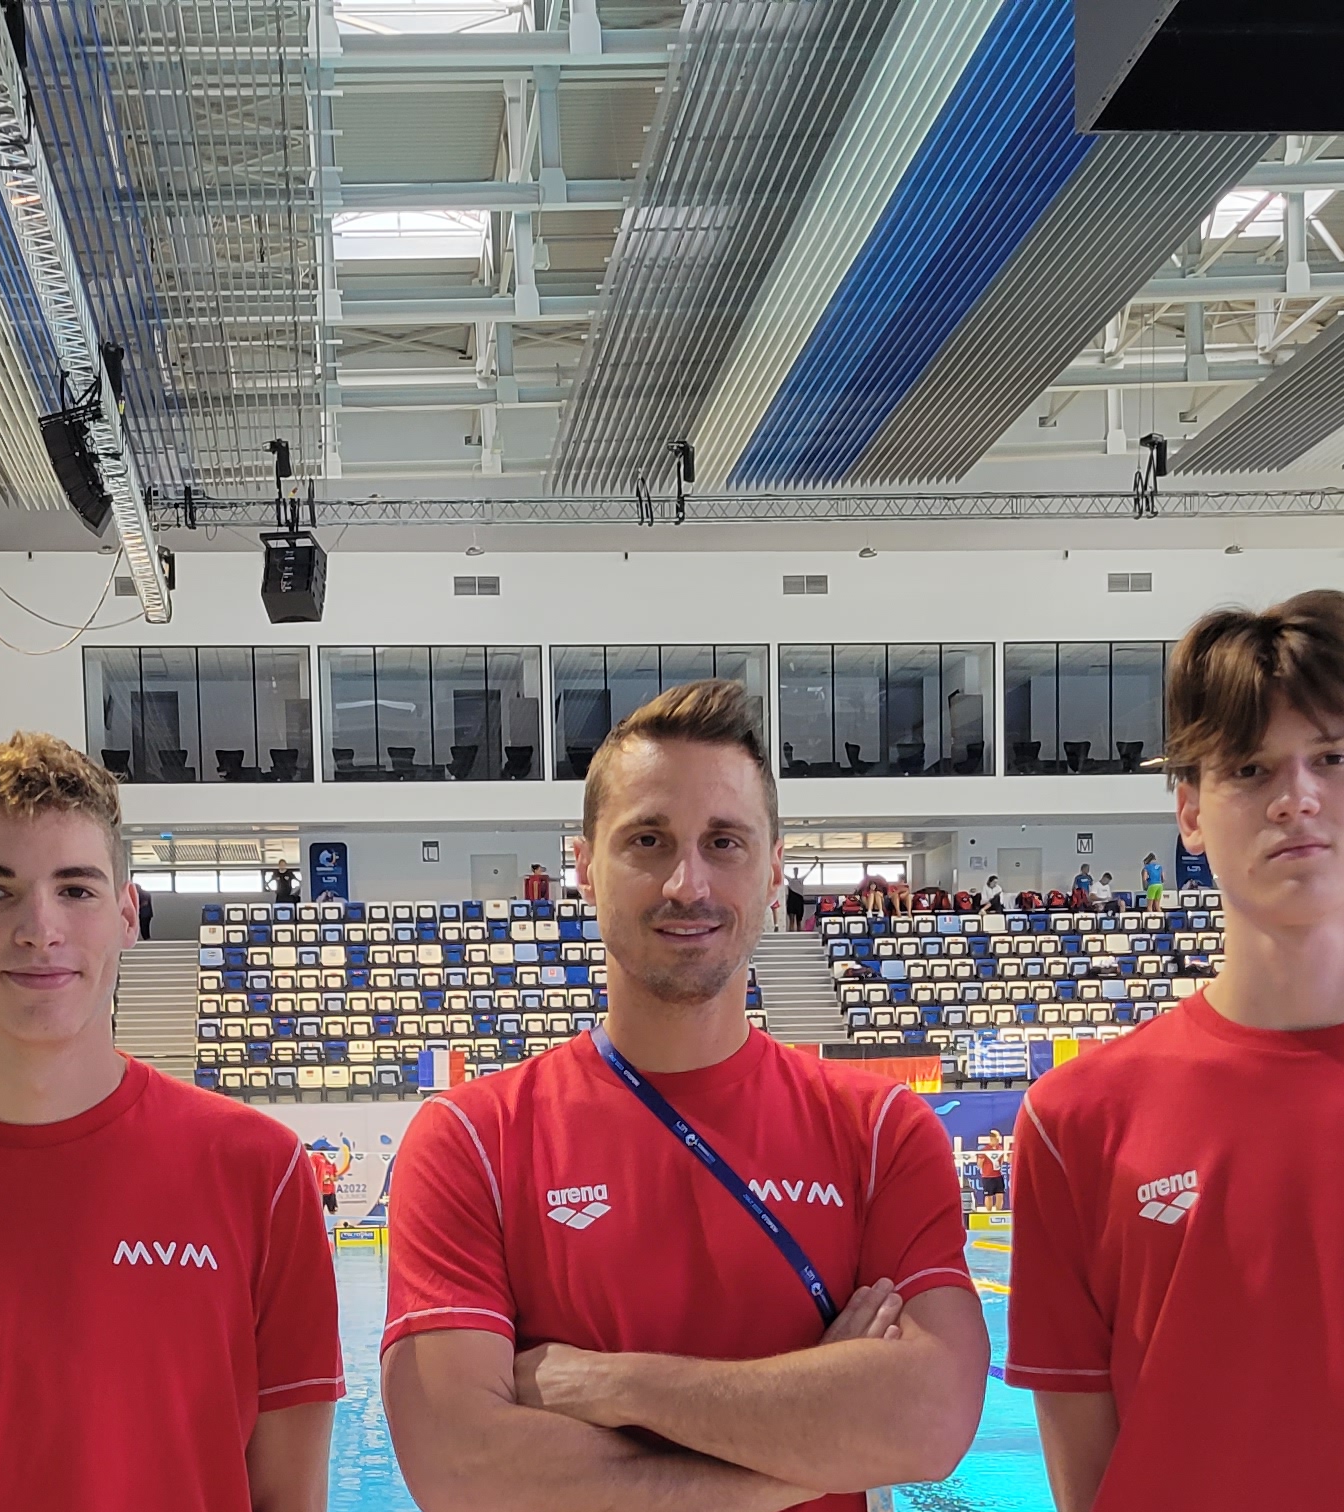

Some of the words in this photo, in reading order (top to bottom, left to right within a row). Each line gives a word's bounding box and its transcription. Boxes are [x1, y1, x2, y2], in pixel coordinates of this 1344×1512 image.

[1080, 839, 1090, 851] M
[547, 1183, 608, 1207] arena
[748, 1178, 844, 1208] MVM
[1136, 1169, 1198, 1203] arena
[113, 1240, 218, 1271] MVM
